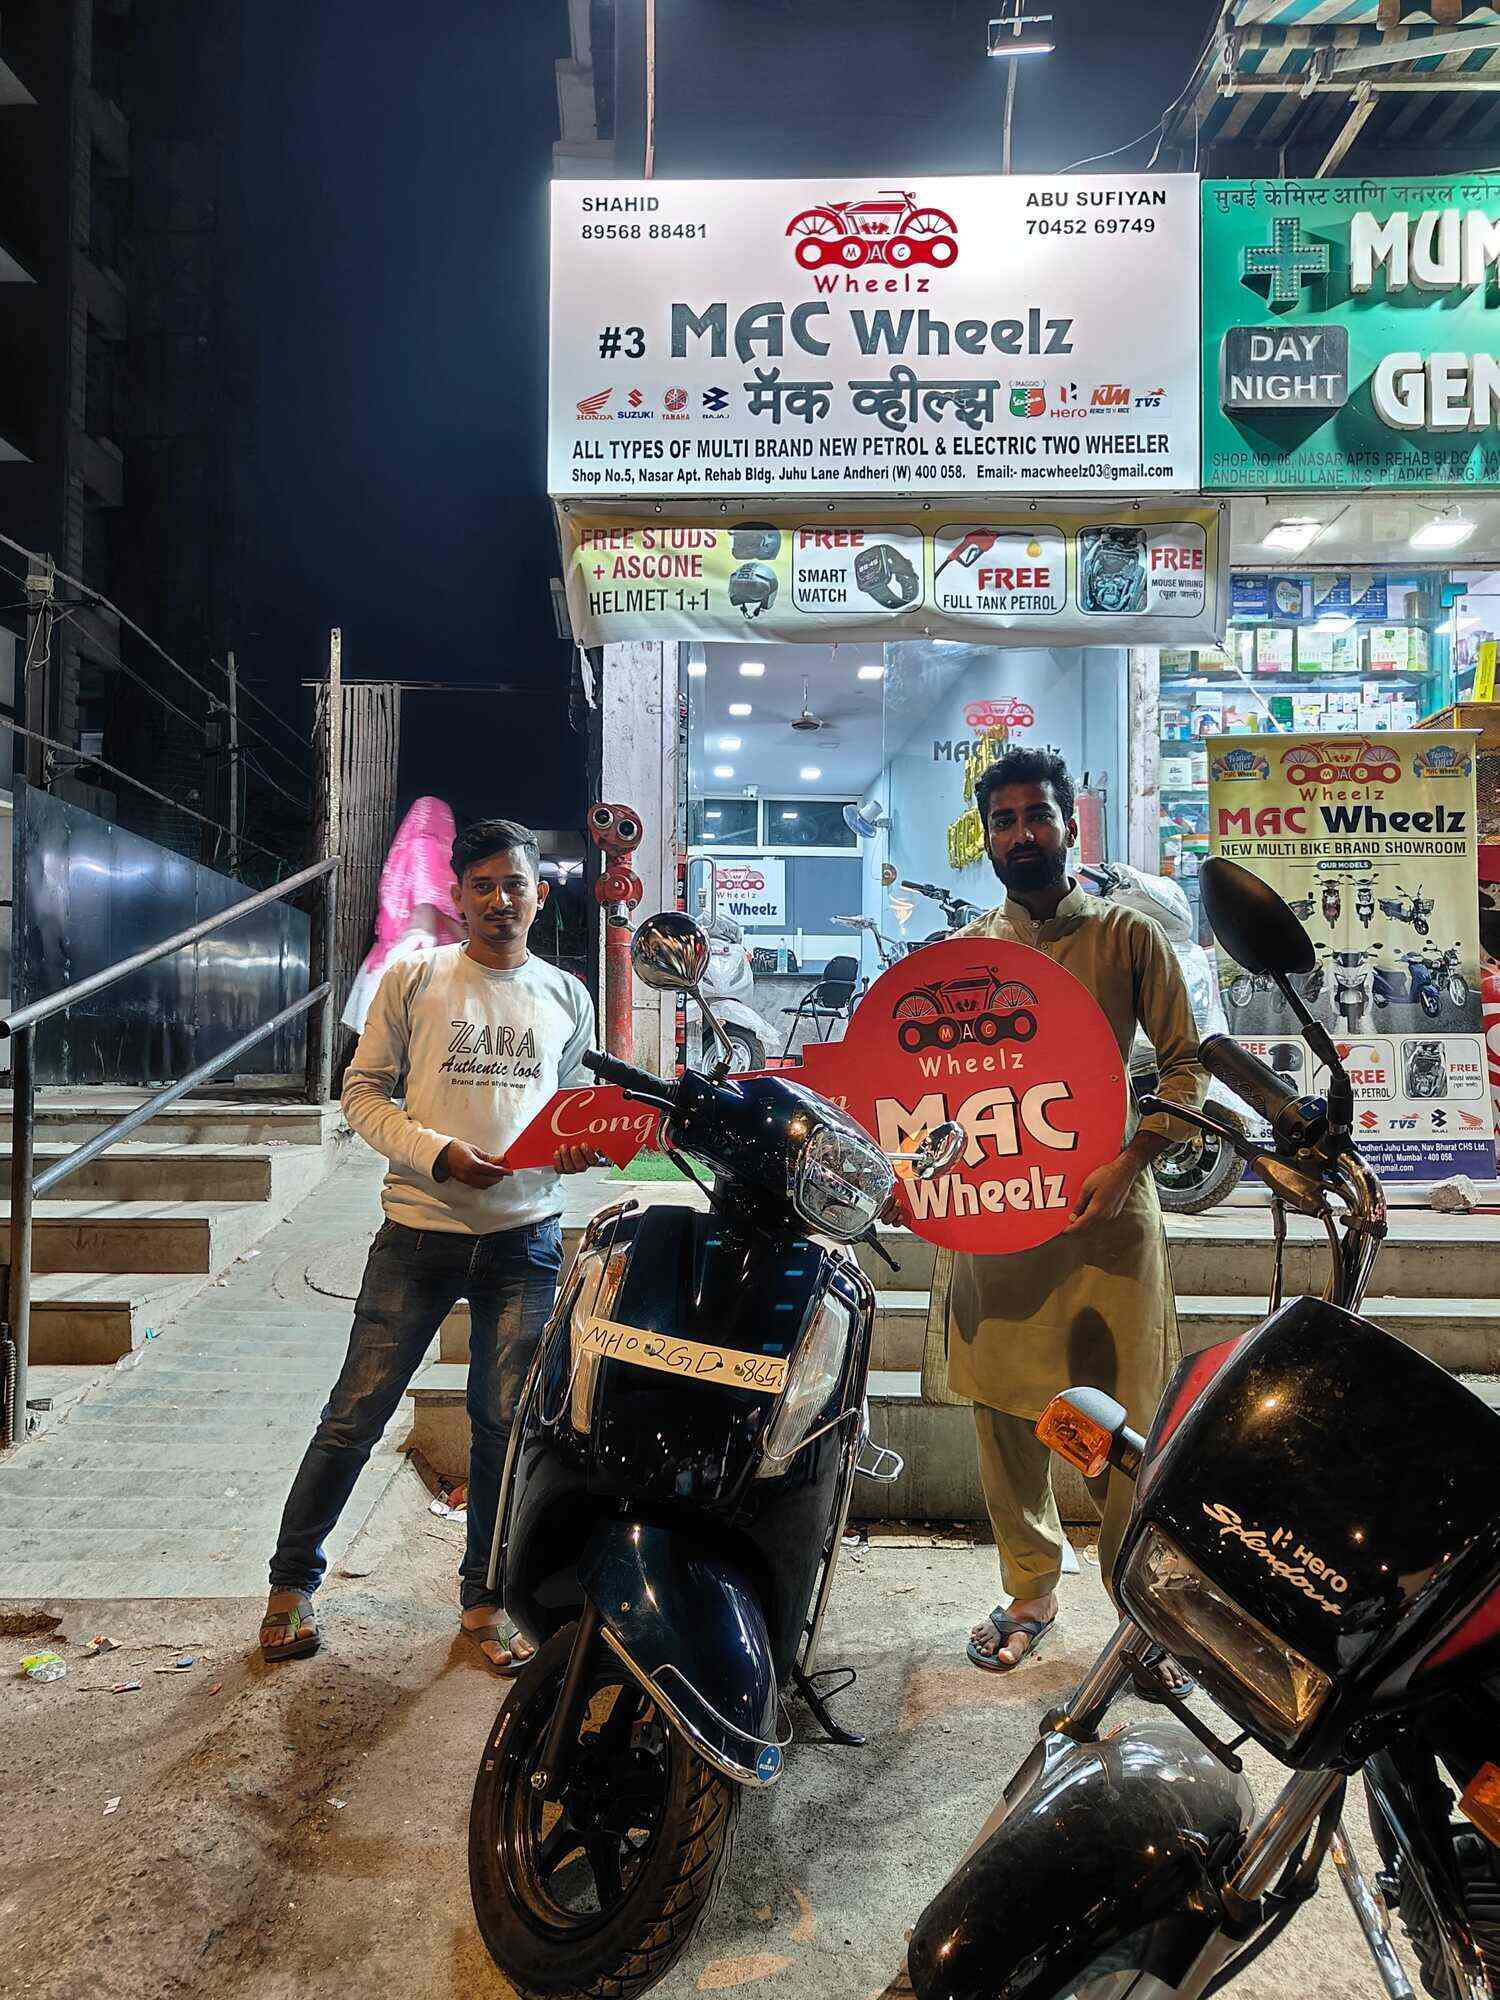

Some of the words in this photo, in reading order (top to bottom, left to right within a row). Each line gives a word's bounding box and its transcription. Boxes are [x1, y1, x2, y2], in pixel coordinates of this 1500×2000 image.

[1026, 192, 1068, 207] ABU
[1076, 191, 1167, 206] SUFIYAN
[1263, 181, 1330, 206] केमिस्ट
[1333, 180, 1387, 204] आणि
[1390, 186, 1456, 207] जनरल
[582, 197, 659, 212] SHAHID
[582, 225, 641, 239] 89568
[649, 224, 707, 239] 88481
[1026, 219, 1087, 235] 70452
[1094, 218, 1155, 234] 69749
[813, 274, 931, 293] Wheelz
[599, 326, 646, 359] #3
[671, 301, 831, 364] MAC
[849, 308, 1074, 356] Wheelz
[1250, 335, 1322, 362] DAY
[1090, 384, 1130, 406] KTM
[1231, 374, 1343, 401] NIGHT
[1134, 397, 1161, 408] TVS
[617, 411, 655, 419] SUZUKI
[572, 440, 604, 460] ALL
[609, 440, 664, 460] TYPES
[669, 439, 691, 459] OF
[697, 439, 749, 459] MULTI
[755, 438, 814, 458] BRAND
[819, 438, 858, 457] NEW
[863, 436, 929, 456] PETROL
[935, 436, 946, 455] &
[953, 436, 1036, 455] ELECTRIC
[1041, 435, 1080, 455] TWO
[1085, 434, 1170, 454] WHEELER
[1212, 453, 1248, 466] SHOP
[1299, 452, 1342, 466] NASAR
[1347, 452, 1380, 466] APTS
[1385, 451, 1430, 465] REHAB
[572, 468, 601, 486] Shop
[605, 468, 635, 485] No.5,
[638, 468, 673, 482] Nasar
[676, 467, 700, 485] Apt.
[704, 467, 741, 482] Rehab
[745, 467, 775, 485] Bldg.
[778, 467, 808, 481] Juhu
[811, 467, 840, 481] Lane
[843, 465, 889, 481] Andheri
[892, 465, 912, 483] (W)
[915, 466, 937, 480] 400
[940, 466, 966, 480] 058.
[1021, 463, 1174, 481] macwheelz03@gmail.com
[1211, 470, 1268, 484] ANDHERI
[1271, 470, 1305, 484] JUHU
[580, 528, 634, 551] FREE
[642, 527, 717, 550] STUDS
[799, 528, 864, 551] FREE
[593, 565, 605, 580] +
[612, 554, 703, 579] ASCONE
[1151, 548, 1203, 571] FREE
[798, 569, 847, 583] SMART
[978, 567, 1050, 592] FREE
[1151, 579, 1177, 588] MOUSE
[1178, 579, 1203, 588] WIRING
[589, 588, 668, 616] HELMET
[675, 588, 710, 612] 1+1
[798, 589, 847, 603] WATCH
[943, 595, 973, 610] FULL
[976, 595, 1008, 611] TANK
[1011, 595, 1057, 611] PETROL
[1299, 786, 1385, 801] Wheelz
[1218, 807, 1307, 837] MAC
[1320, 805, 1466, 834] Wheelz
[1221, 844, 1253, 856] NEW
[1257, 843, 1297, 856] MULTI
[1300, 842, 1331, 855] BIKE
[1335, 842, 1380, 854] BRAND
[1385, 841, 1466, 854] SHOWROOM
[1320, 861, 1337, 869] OUR
[1338, 860, 1369, 869] MODELS
[729, 903, 778, 915] Wheelz
[448, 1020, 535, 1058] ZARA
[1240, 1043, 1267, 1055] REE
[439, 1055, 508, 1075] Authentic
[513, 1061, 542, 1079] look
[919, 1048, 1025, 1078] Wheelz
[1450, 1064, 1478, 1072] FREE
[475, 1079, 490, 1087] and
[491, 1079, 508, 1088] style
[1350, 1070, 1386, 1084] REE
[1362, 1088, 1390, 1098] PETROL
[875, 1081, 1077, 1168] MAC
[1389, 1120, 1416, 1129] TVS
[1384, 1143, 1400, 1152] Juhu
[1402, 1143, 1420, 1152] Lane,
[1422, 1143, 1434, 1151] Nav
[1435, 1142, 1458, 1151] Bharat
[1459, 1142, 1473, 1151] CHS
[1397, 1153, 1422, 1162] Mumbai
[902, 1166, 1068, 1220] Wheelz
[1293, 1544, 1348, 1593] Hero
